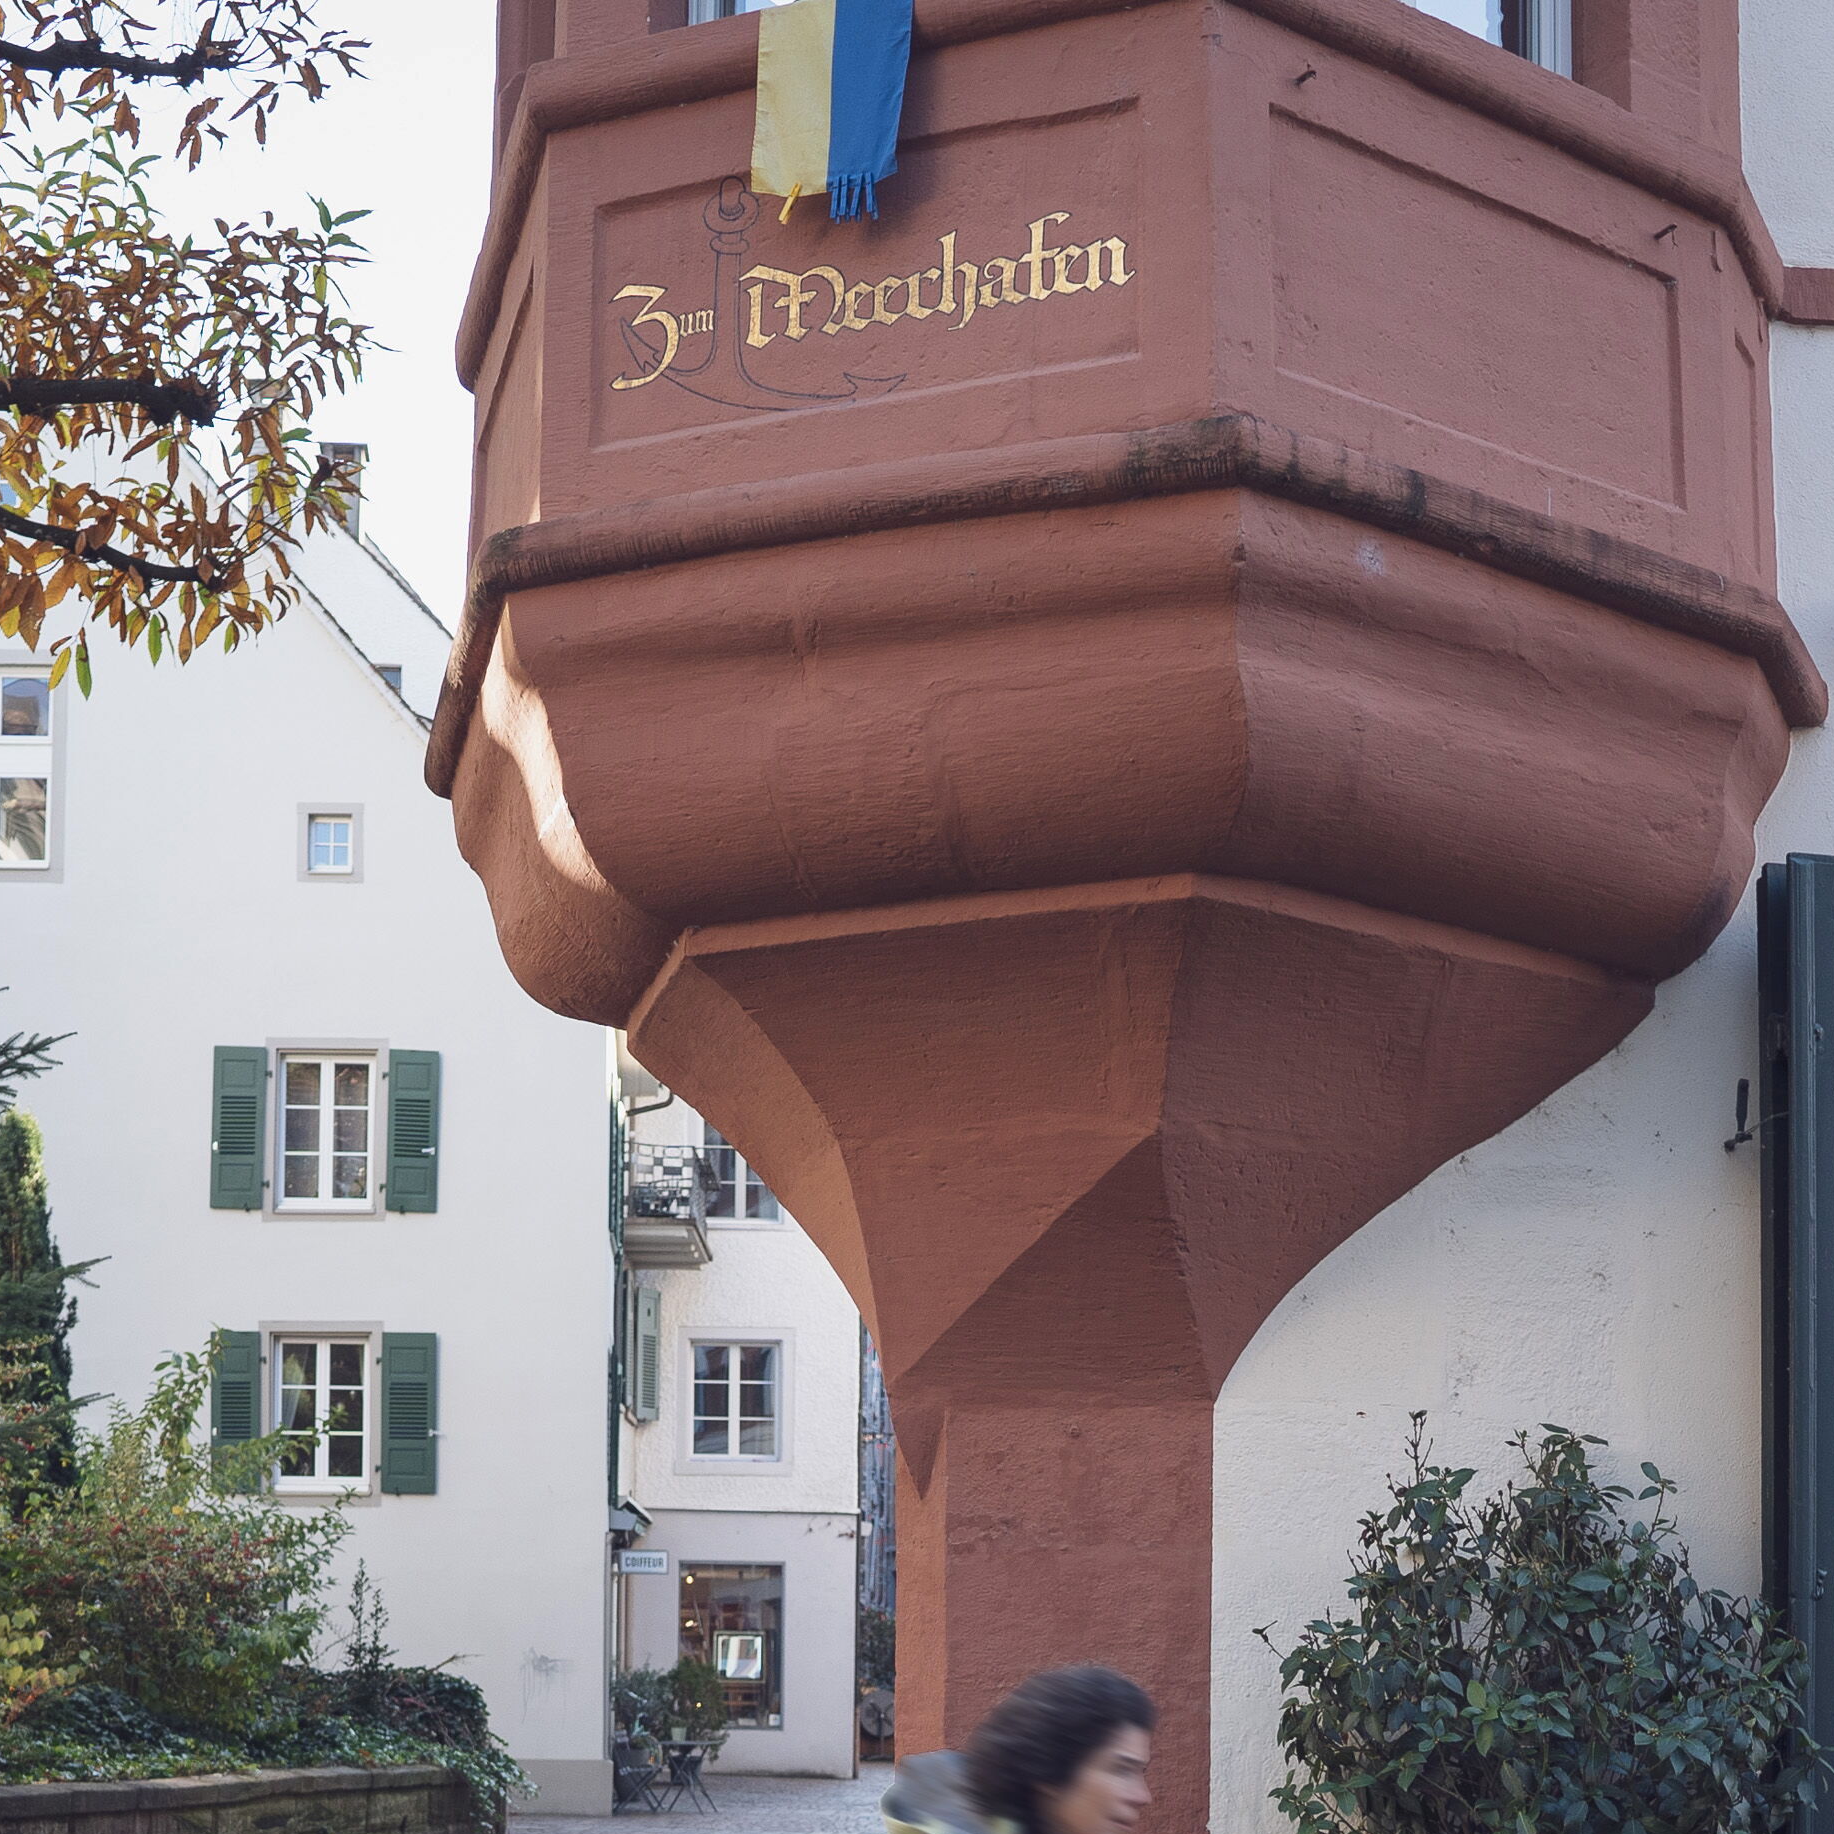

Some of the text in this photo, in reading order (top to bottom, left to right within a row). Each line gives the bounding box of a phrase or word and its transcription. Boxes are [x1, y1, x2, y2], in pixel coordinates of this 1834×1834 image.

[609, 210, 1137, 392] Zum Meerhafen
[625, 1557, 664, 1568] COIFFEUR
